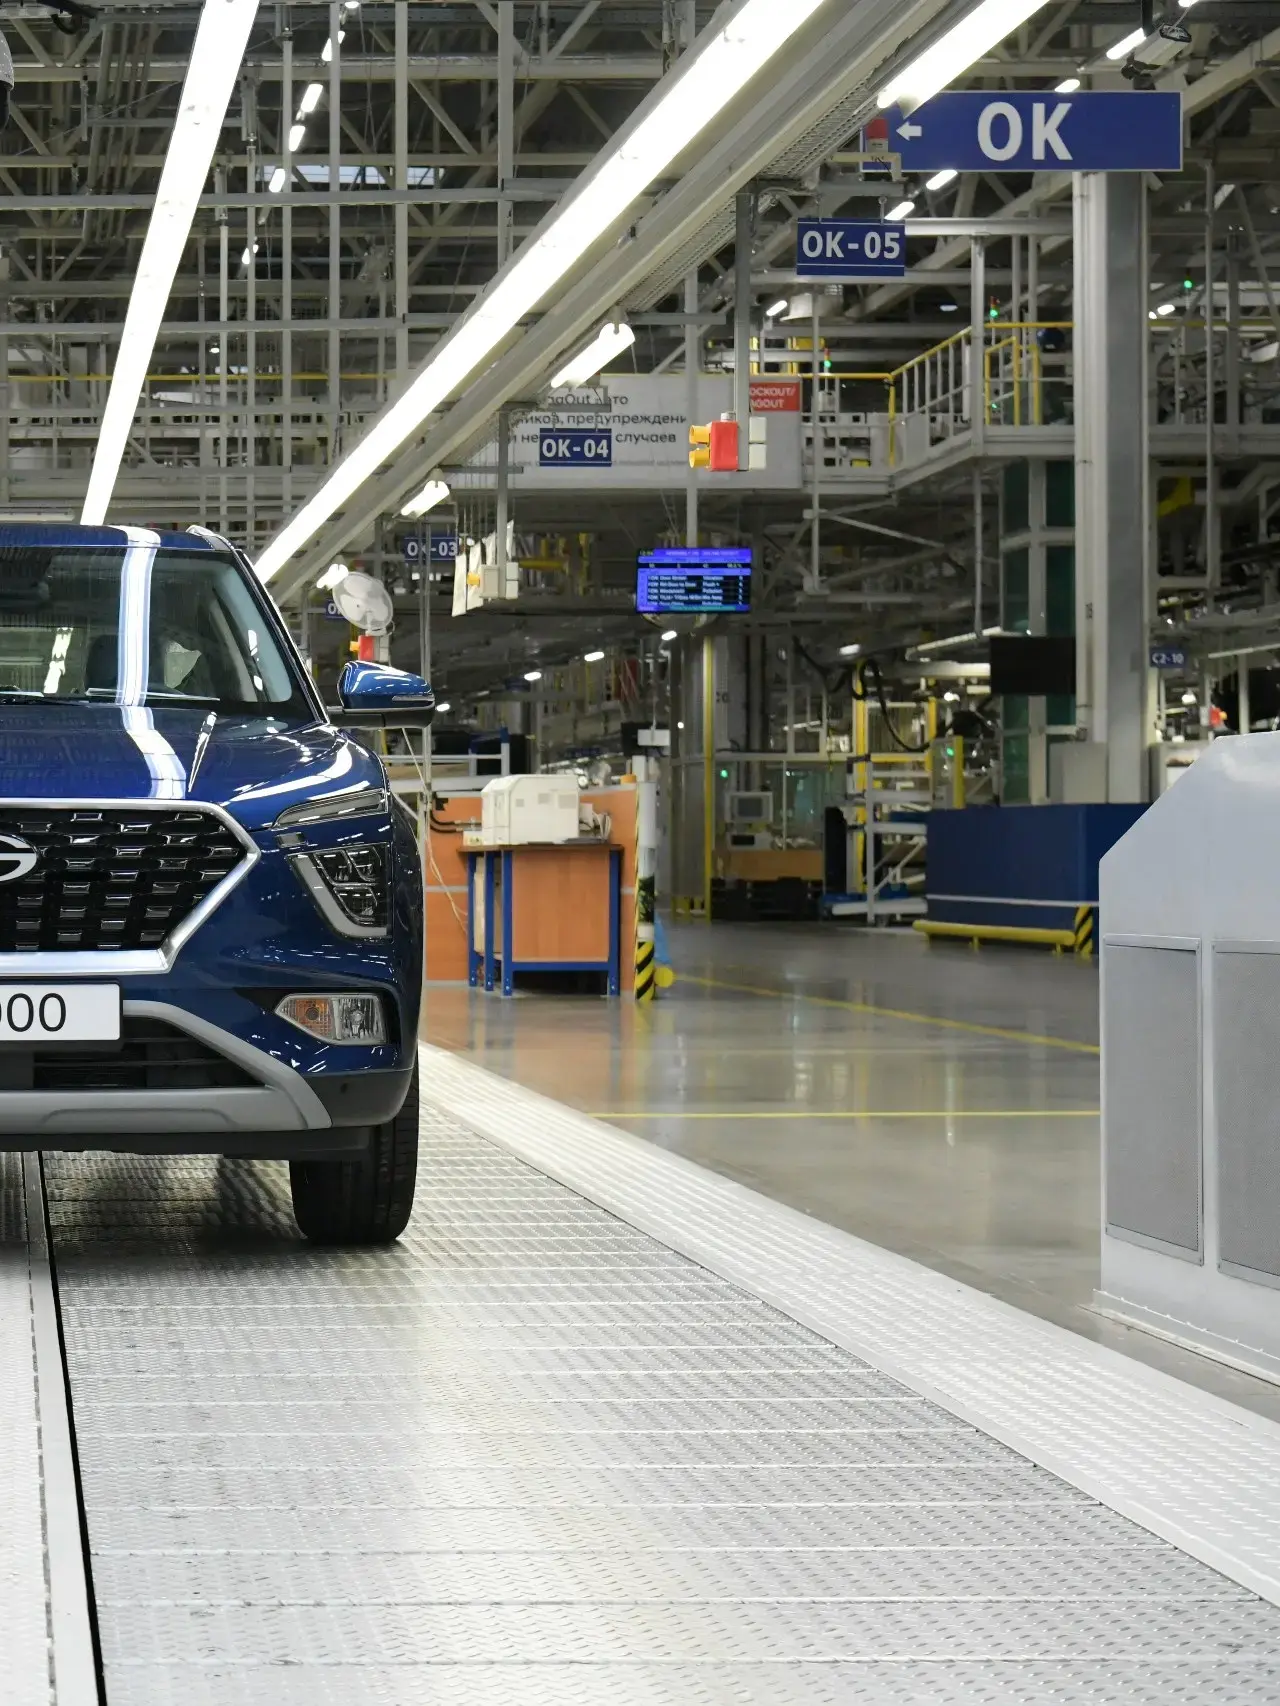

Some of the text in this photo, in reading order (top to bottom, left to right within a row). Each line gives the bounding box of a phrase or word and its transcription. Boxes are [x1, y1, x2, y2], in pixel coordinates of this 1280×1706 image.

[977, 101, 1073, 161] OK
[802, 230, 900, 259] OK-05
[749, 385, 797, 397] OCKOUT/
[567, 413, 687, 426] предупреждени
[542, 438, 609, 458] OK-04
